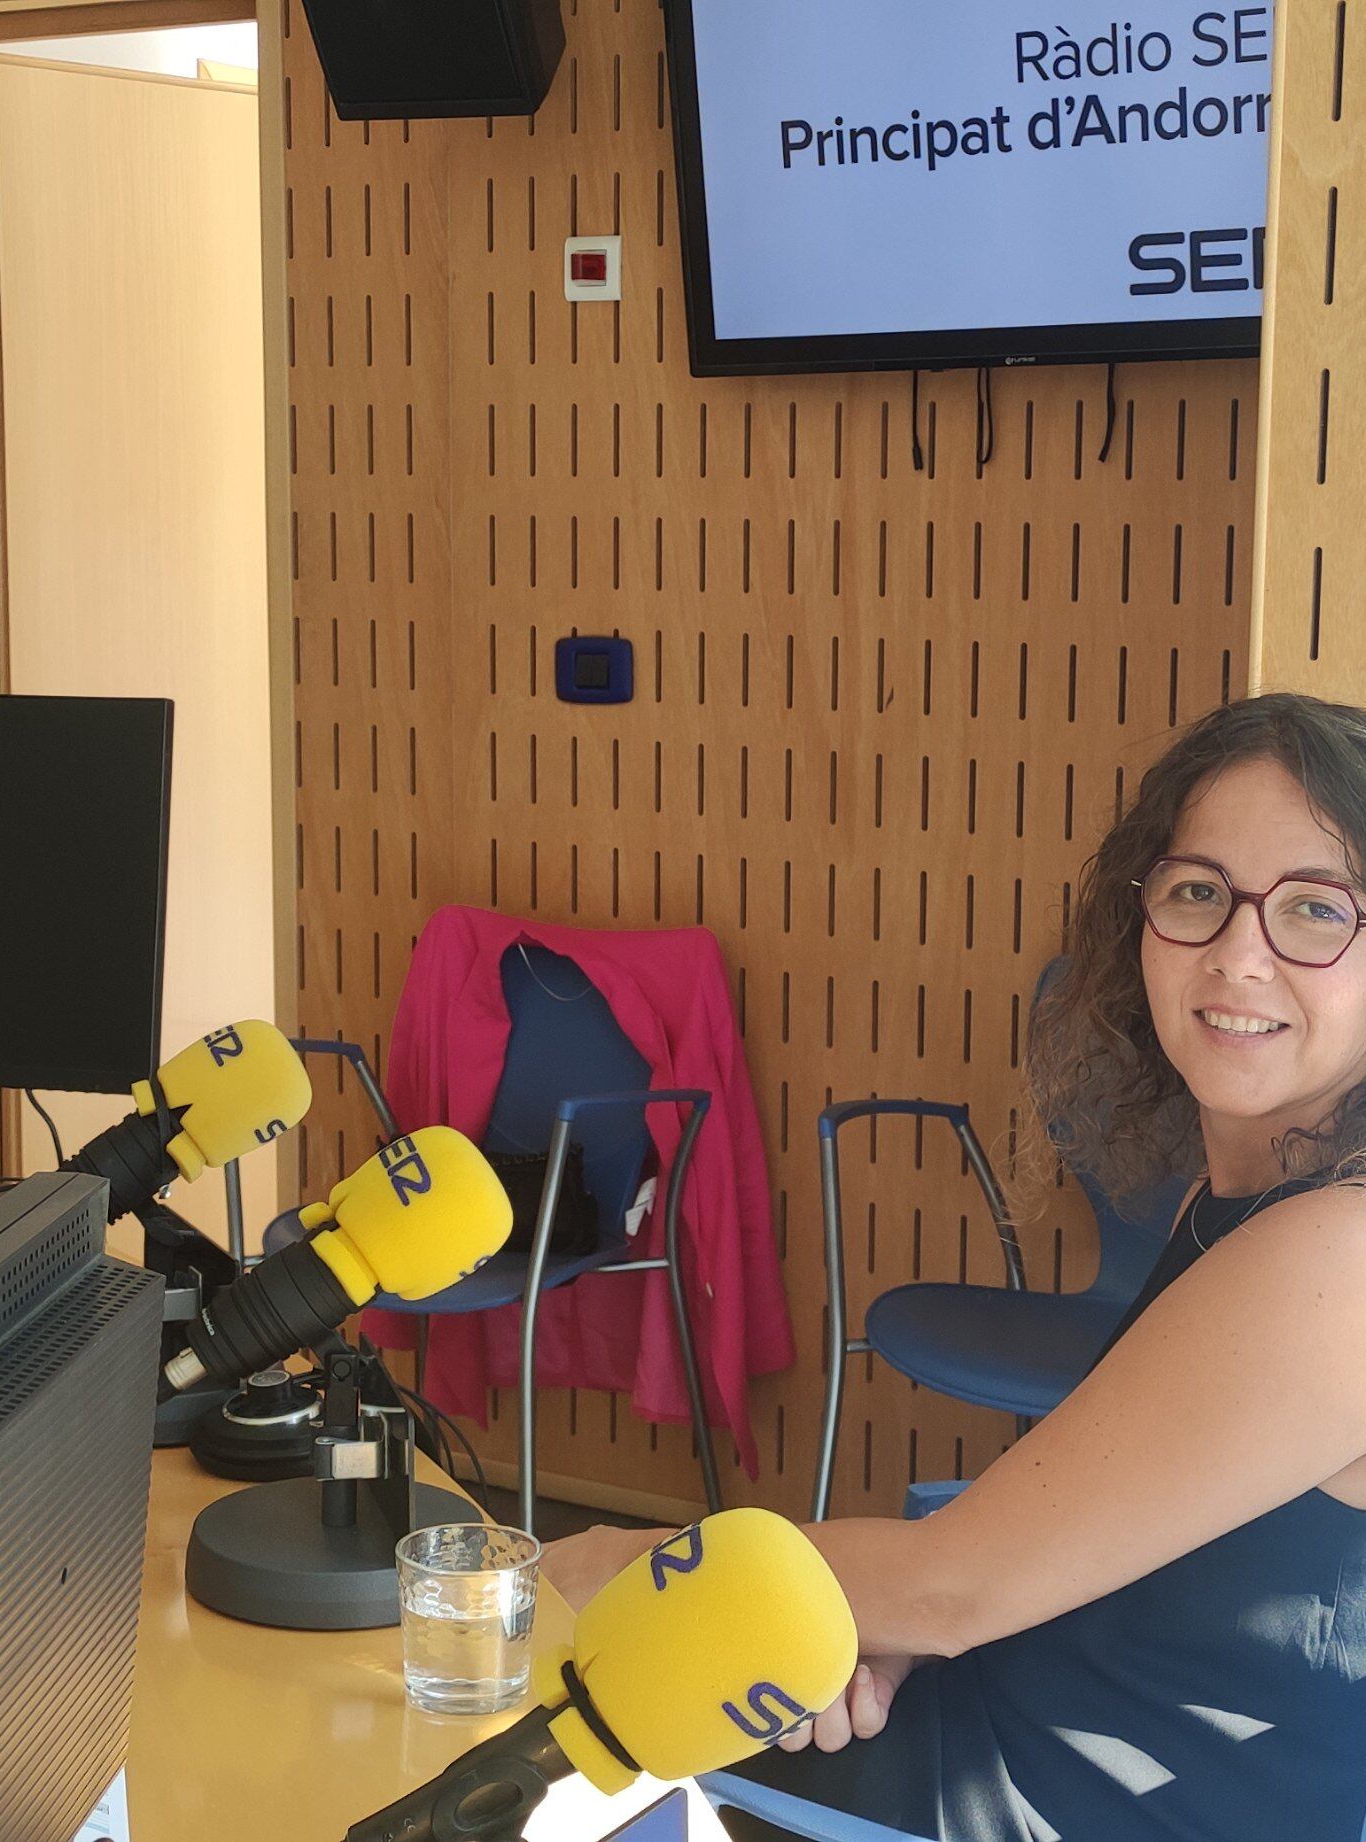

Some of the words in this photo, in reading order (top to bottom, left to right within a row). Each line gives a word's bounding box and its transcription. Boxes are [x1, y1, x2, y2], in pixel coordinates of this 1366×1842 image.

[1015, 23, 1173, 83] Ràdio
[1192, 7, 1269, 67] SE
[780, 107, 1013, 171] Principat
[1028, 87, 1272, 150] d’Andorr
[378, 1136, 432, 1207] ER
